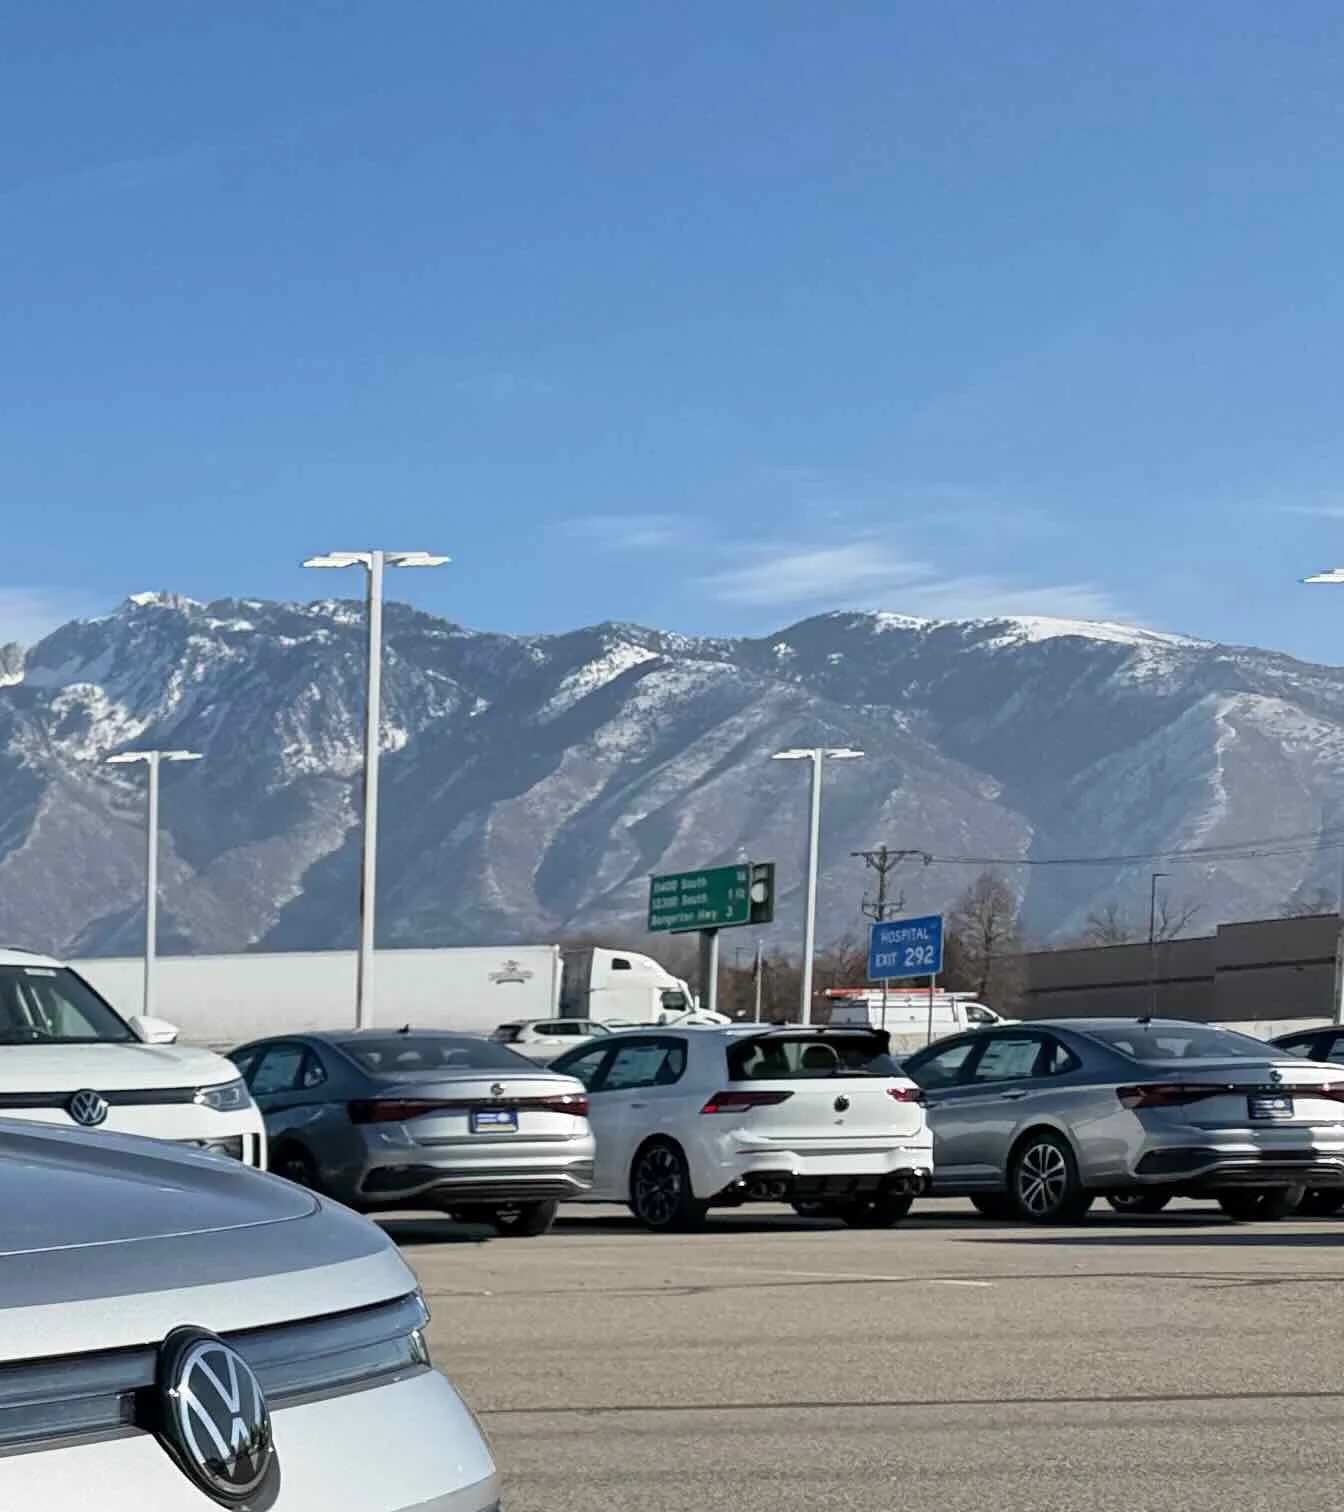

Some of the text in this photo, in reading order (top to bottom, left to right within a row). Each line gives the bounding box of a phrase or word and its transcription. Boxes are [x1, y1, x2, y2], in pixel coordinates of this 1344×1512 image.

[880, 927, 929, 945] HOSPITAL
[875, 944, 934, 968] EXIT 292
